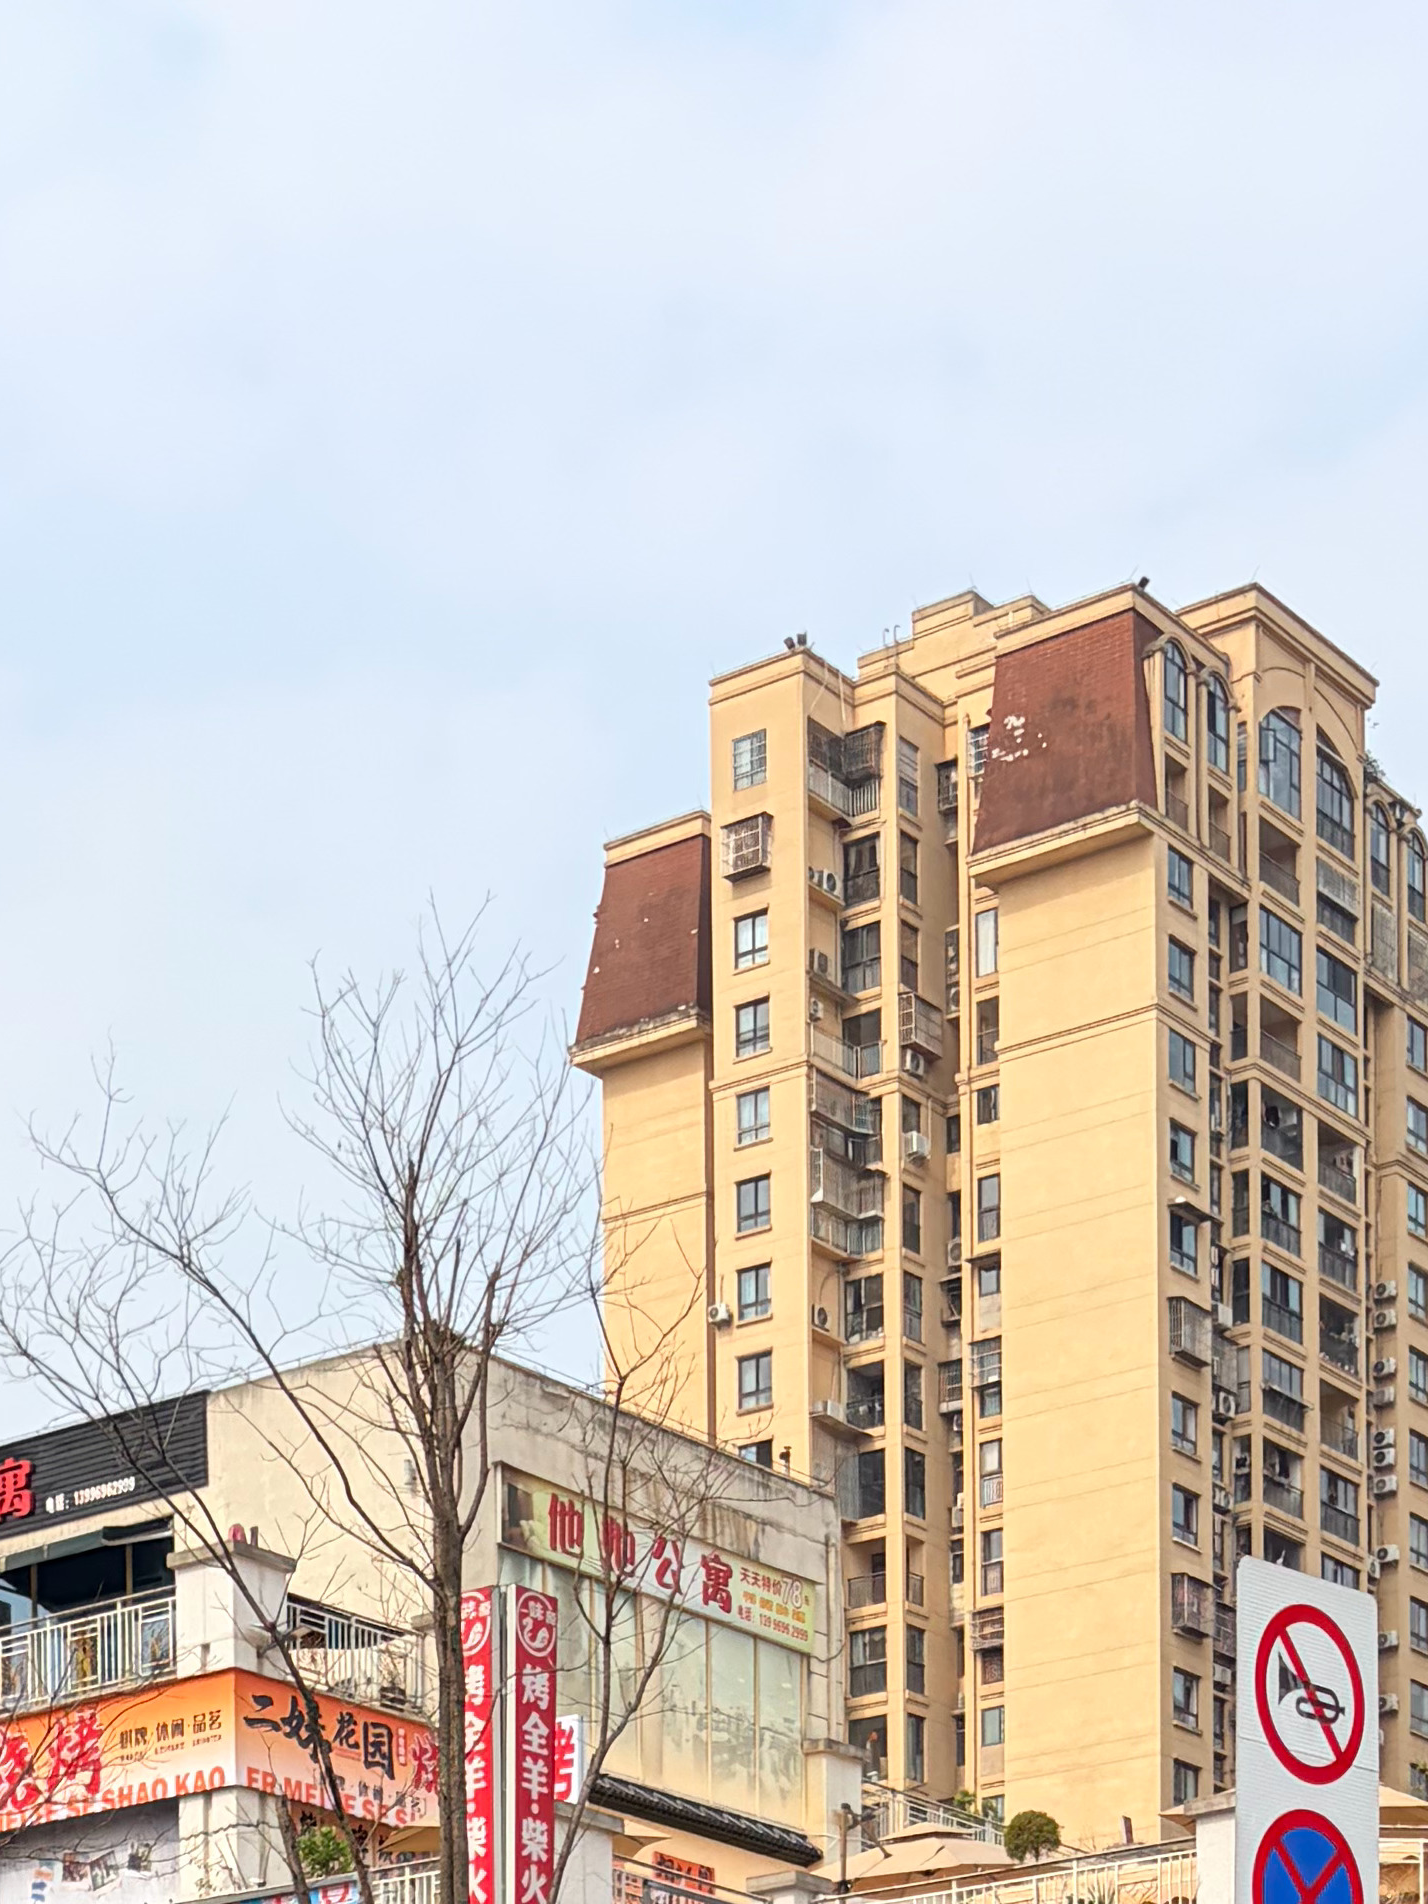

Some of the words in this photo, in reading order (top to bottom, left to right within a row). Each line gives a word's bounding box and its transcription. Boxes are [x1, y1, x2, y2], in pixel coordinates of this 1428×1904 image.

[548, 1492, 733, 1613] 他她公寓
[102, 1780, 169, 1810] SHAO
[175, 1765, 226, 1797] KAO
